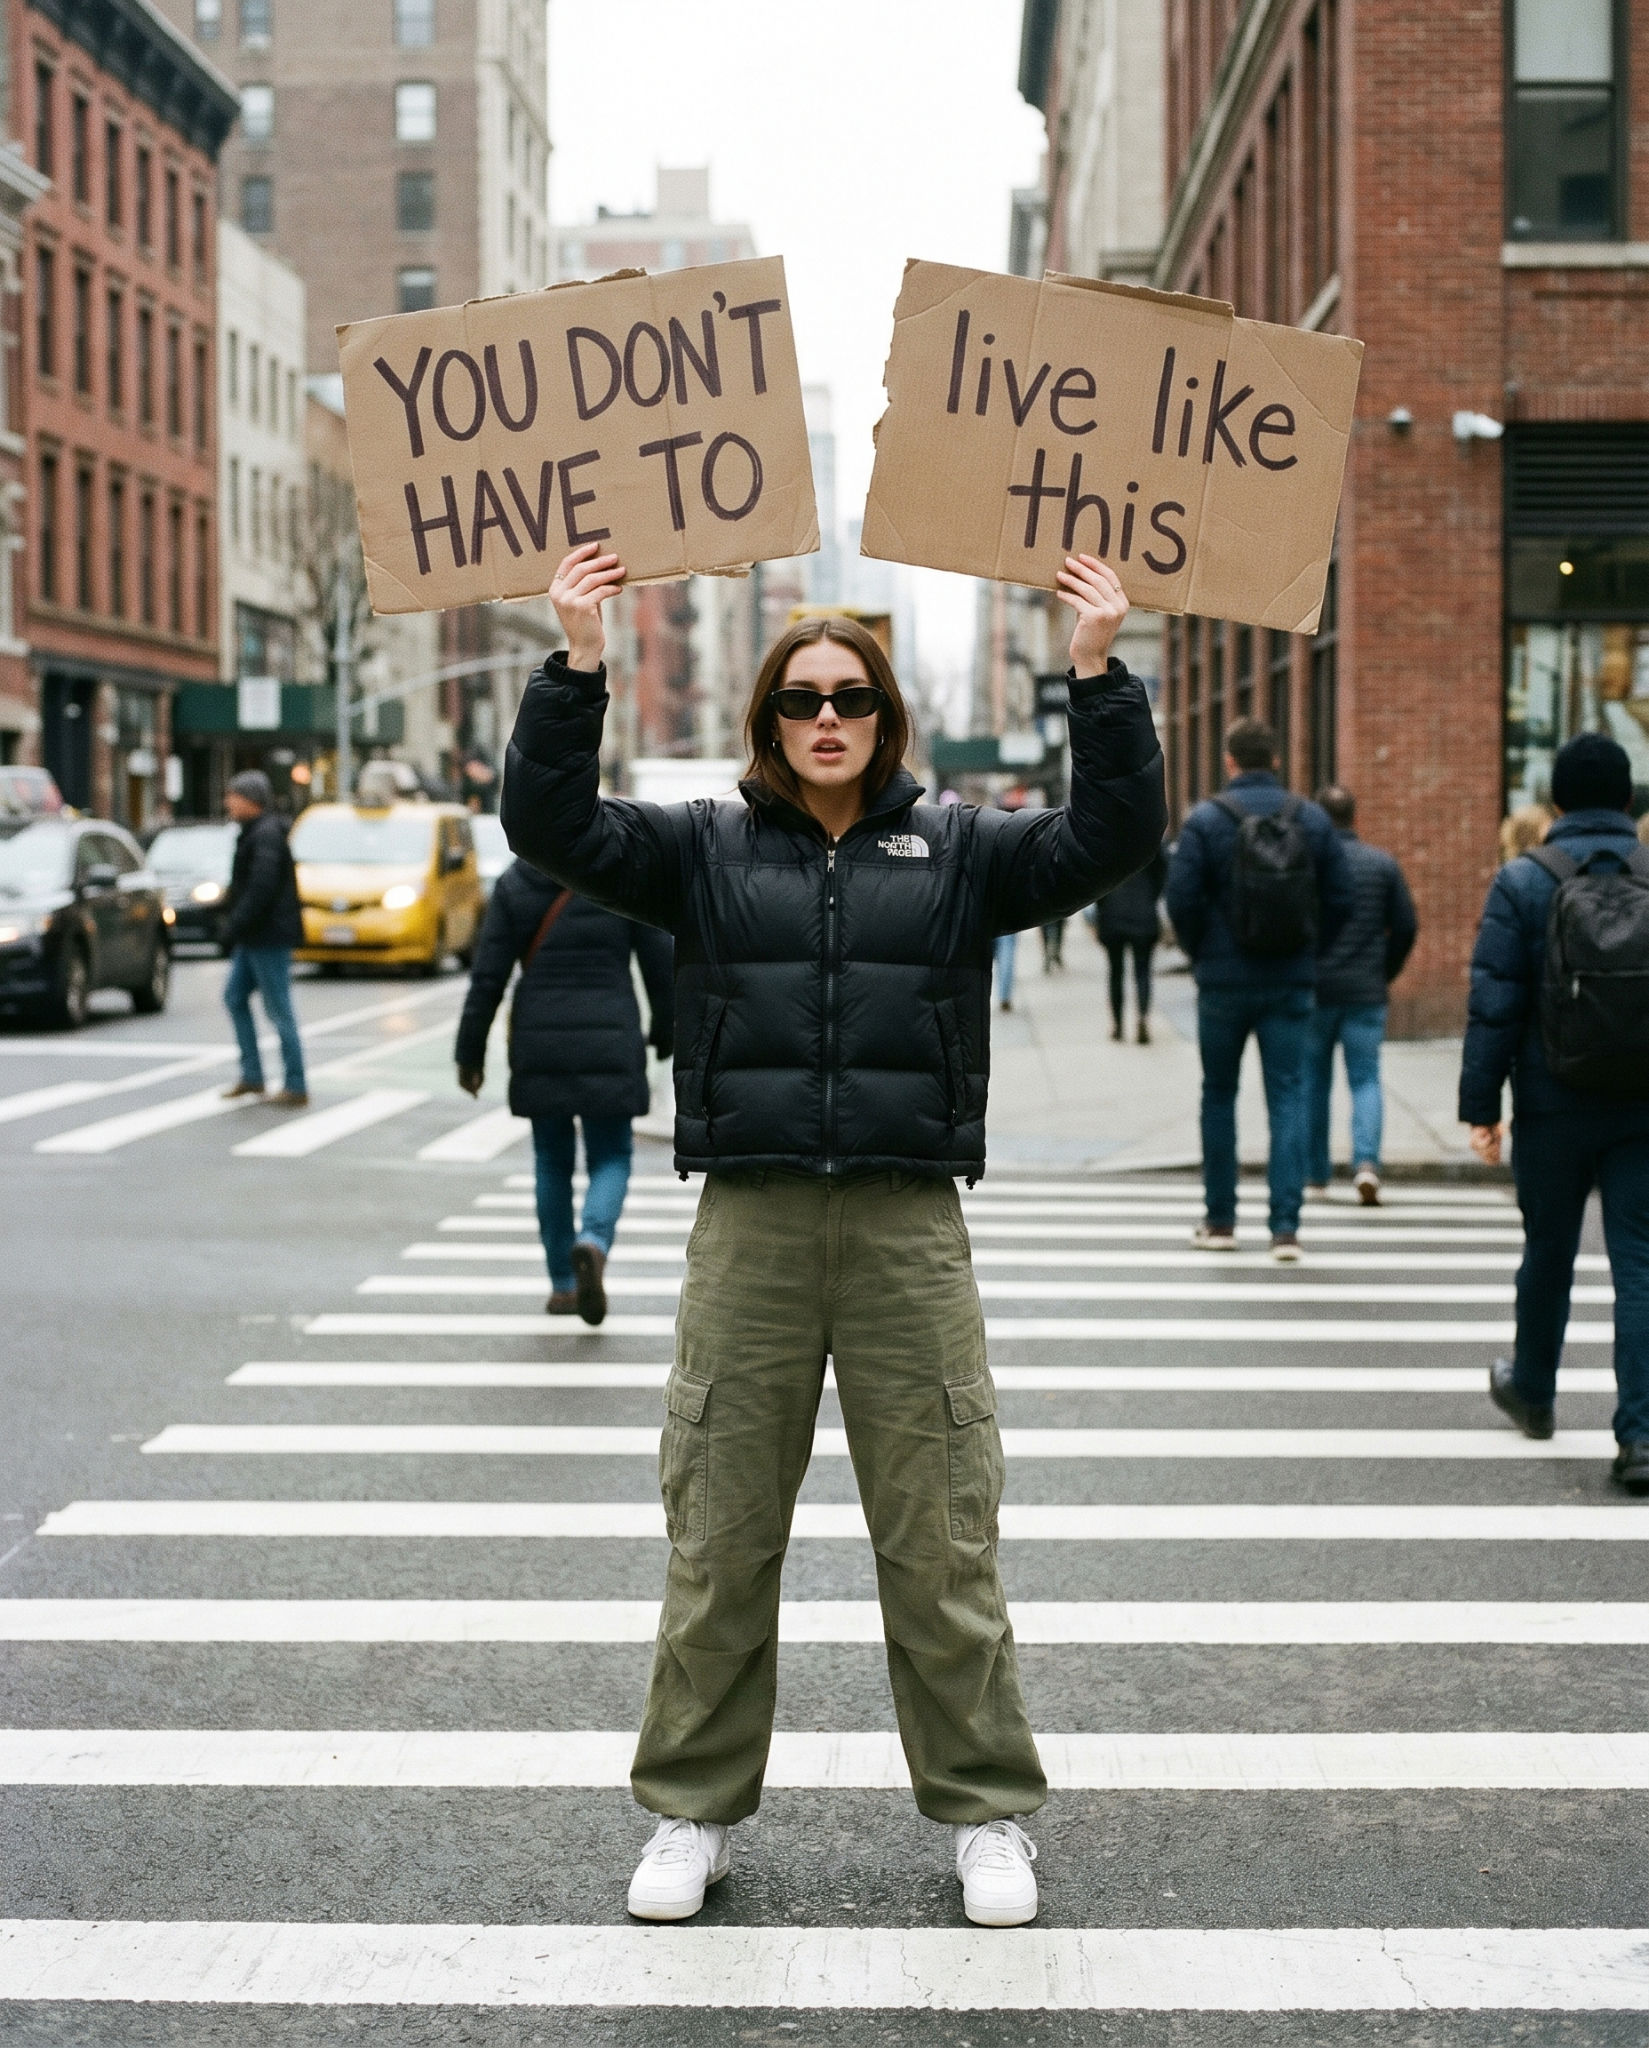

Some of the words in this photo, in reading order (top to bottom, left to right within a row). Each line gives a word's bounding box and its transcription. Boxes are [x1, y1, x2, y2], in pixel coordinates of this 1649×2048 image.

[372, 338, 539, 459] YOU
[565, 290, 782, 422] DON'T
[946, 309, 1098, 436] live
[1151, 345, 1299, 472] like
[403, 449, 612, 577] HAVE
[638, 430, 764, 532] TO
[1006, 447, 1188, 576] this
[890, 835, 910, 843] THE
